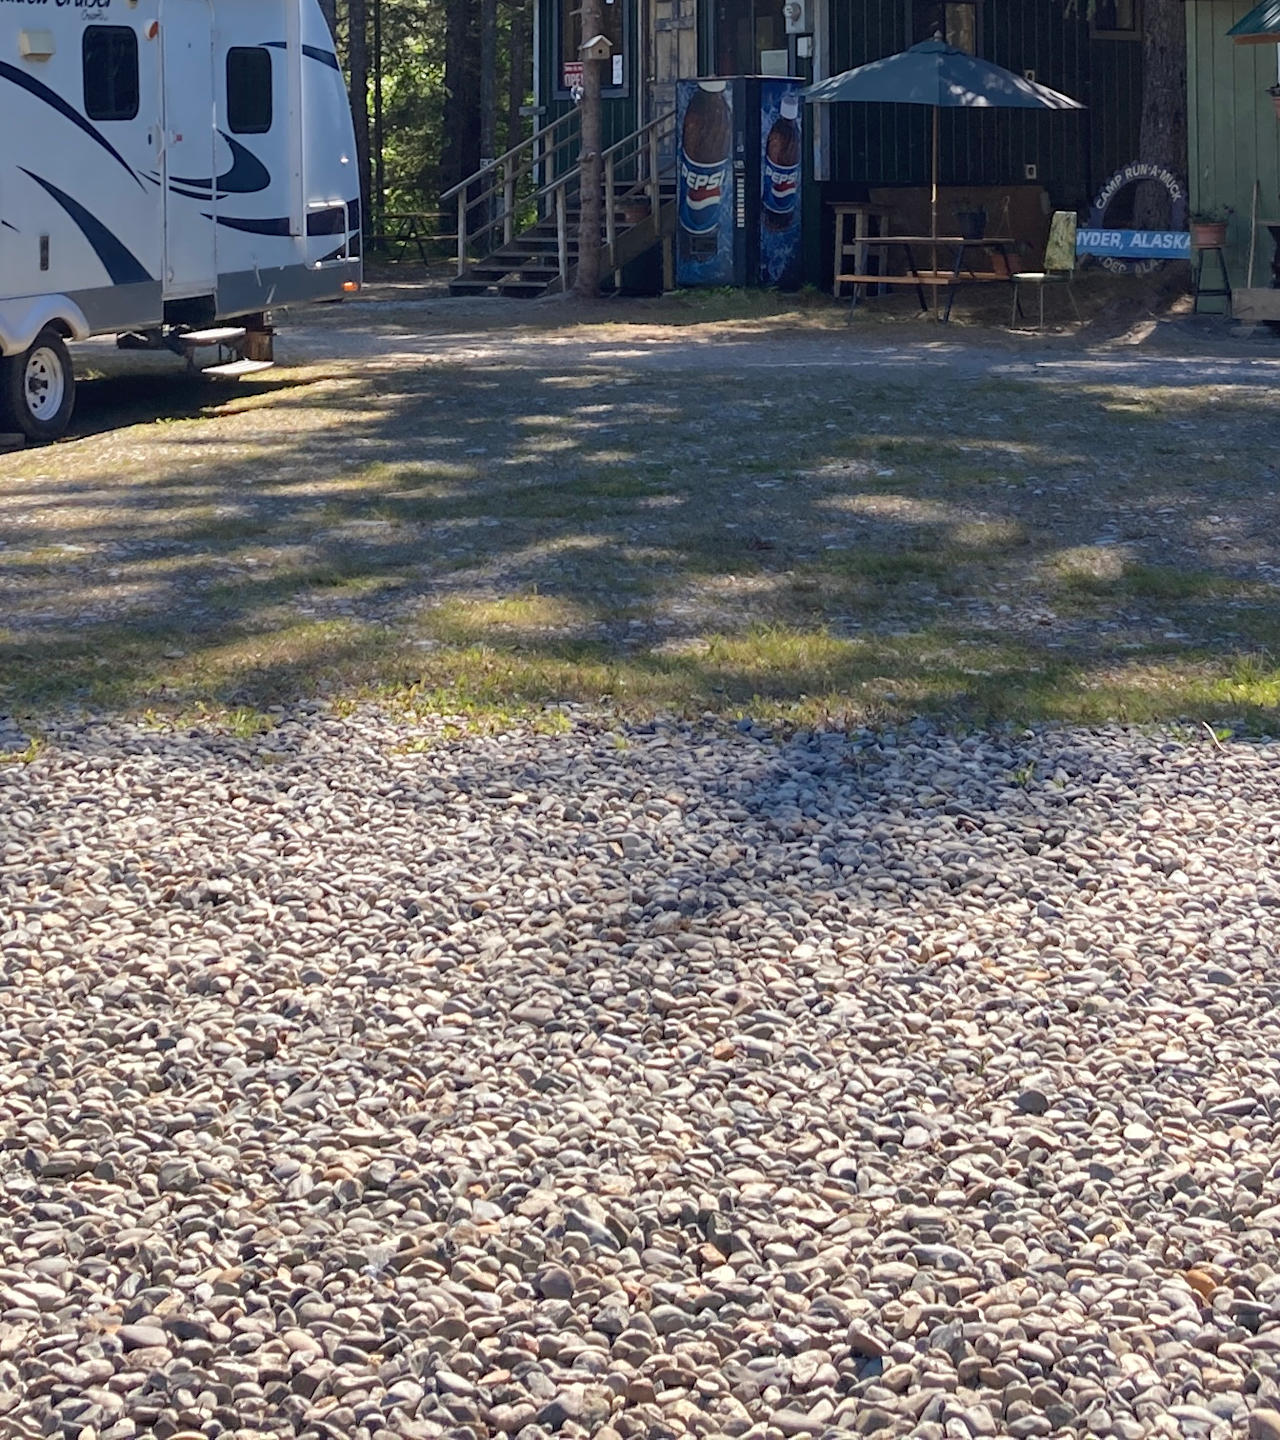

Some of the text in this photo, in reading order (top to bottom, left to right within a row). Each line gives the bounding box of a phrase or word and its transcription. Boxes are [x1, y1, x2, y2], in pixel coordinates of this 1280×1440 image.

[681, 162, 726, 190] PEPSI
[765, 165, 798, 185] PEPSI
[1095, 174, 1123, 209] CAMP
